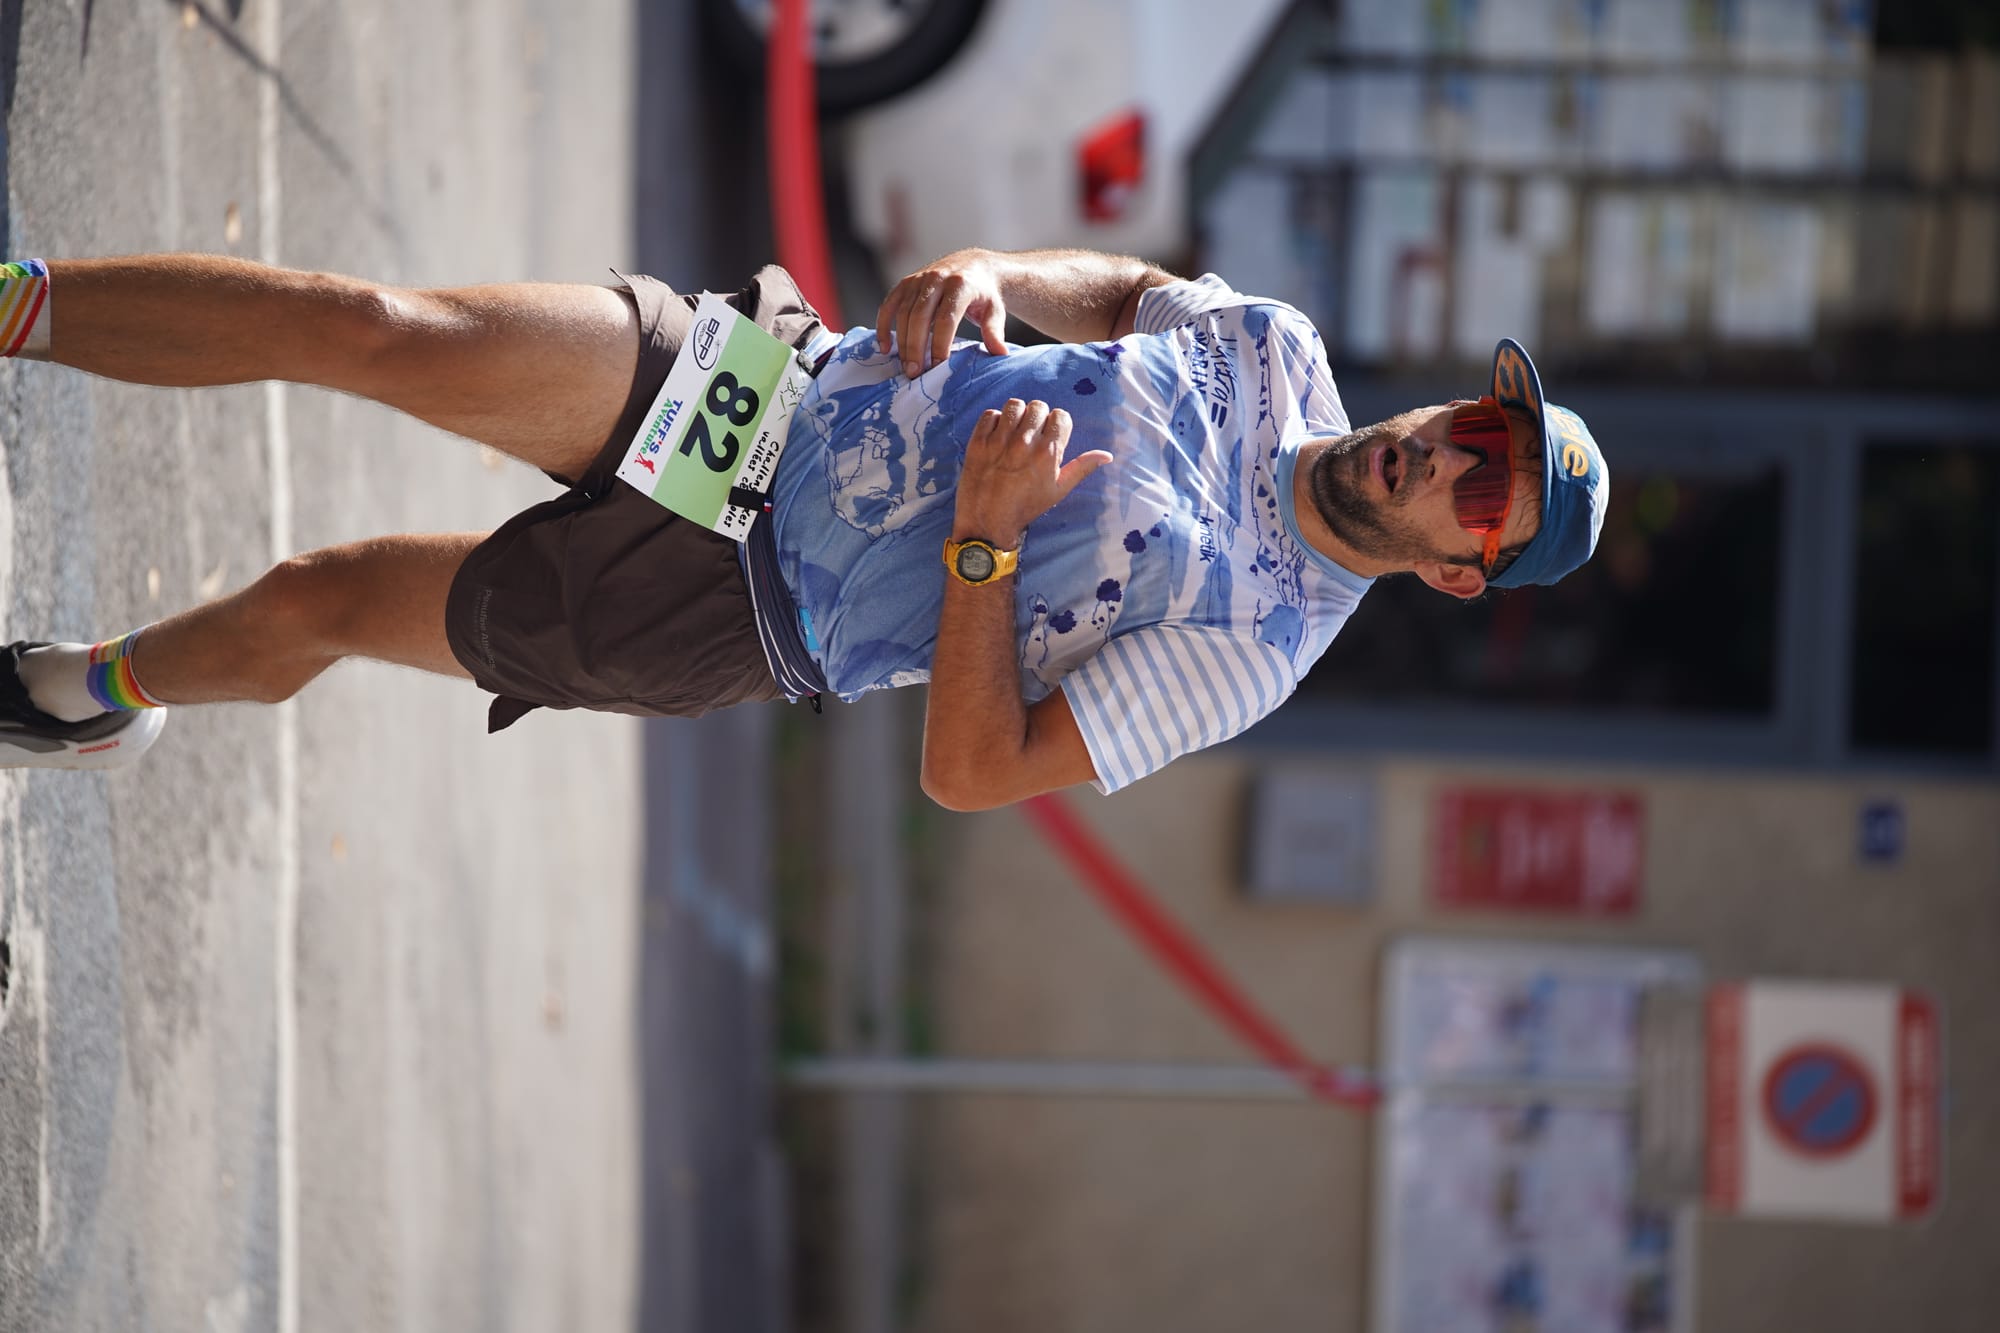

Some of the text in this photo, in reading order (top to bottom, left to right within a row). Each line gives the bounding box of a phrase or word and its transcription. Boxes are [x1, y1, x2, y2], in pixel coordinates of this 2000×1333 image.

[698, 317, 721, 361] BFP
[639, 398, 674, 455] Aventure
[649, 399, 684, 455] TUFF'S
[678, 371, 760, 473] 82
[747, 431, 770, 472] vallées
[749, 440, 780, 492] Challeng
[1199, 515, 1216, 563] kinetik
